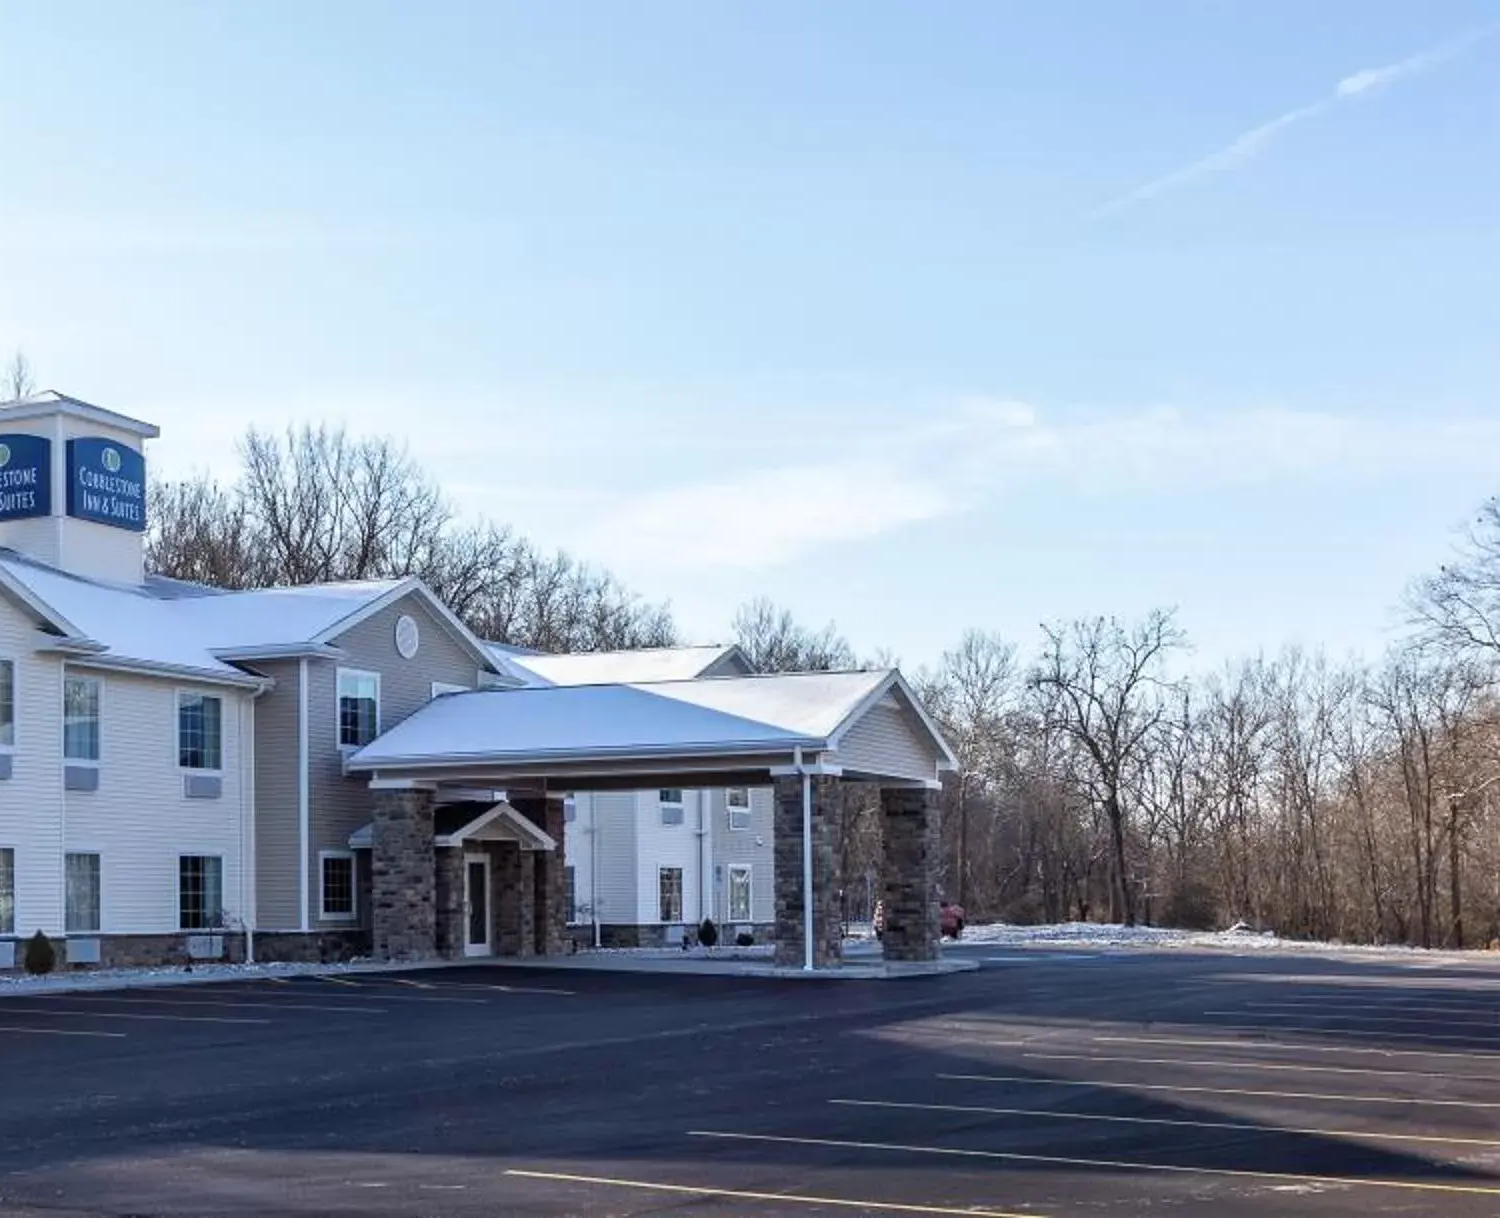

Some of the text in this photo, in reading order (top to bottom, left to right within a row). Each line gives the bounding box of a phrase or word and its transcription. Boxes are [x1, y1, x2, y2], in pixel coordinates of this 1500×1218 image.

[79, 466, 141, 499] COBBLESTONE
[83, 489, 140, 521] INN & SUITES
